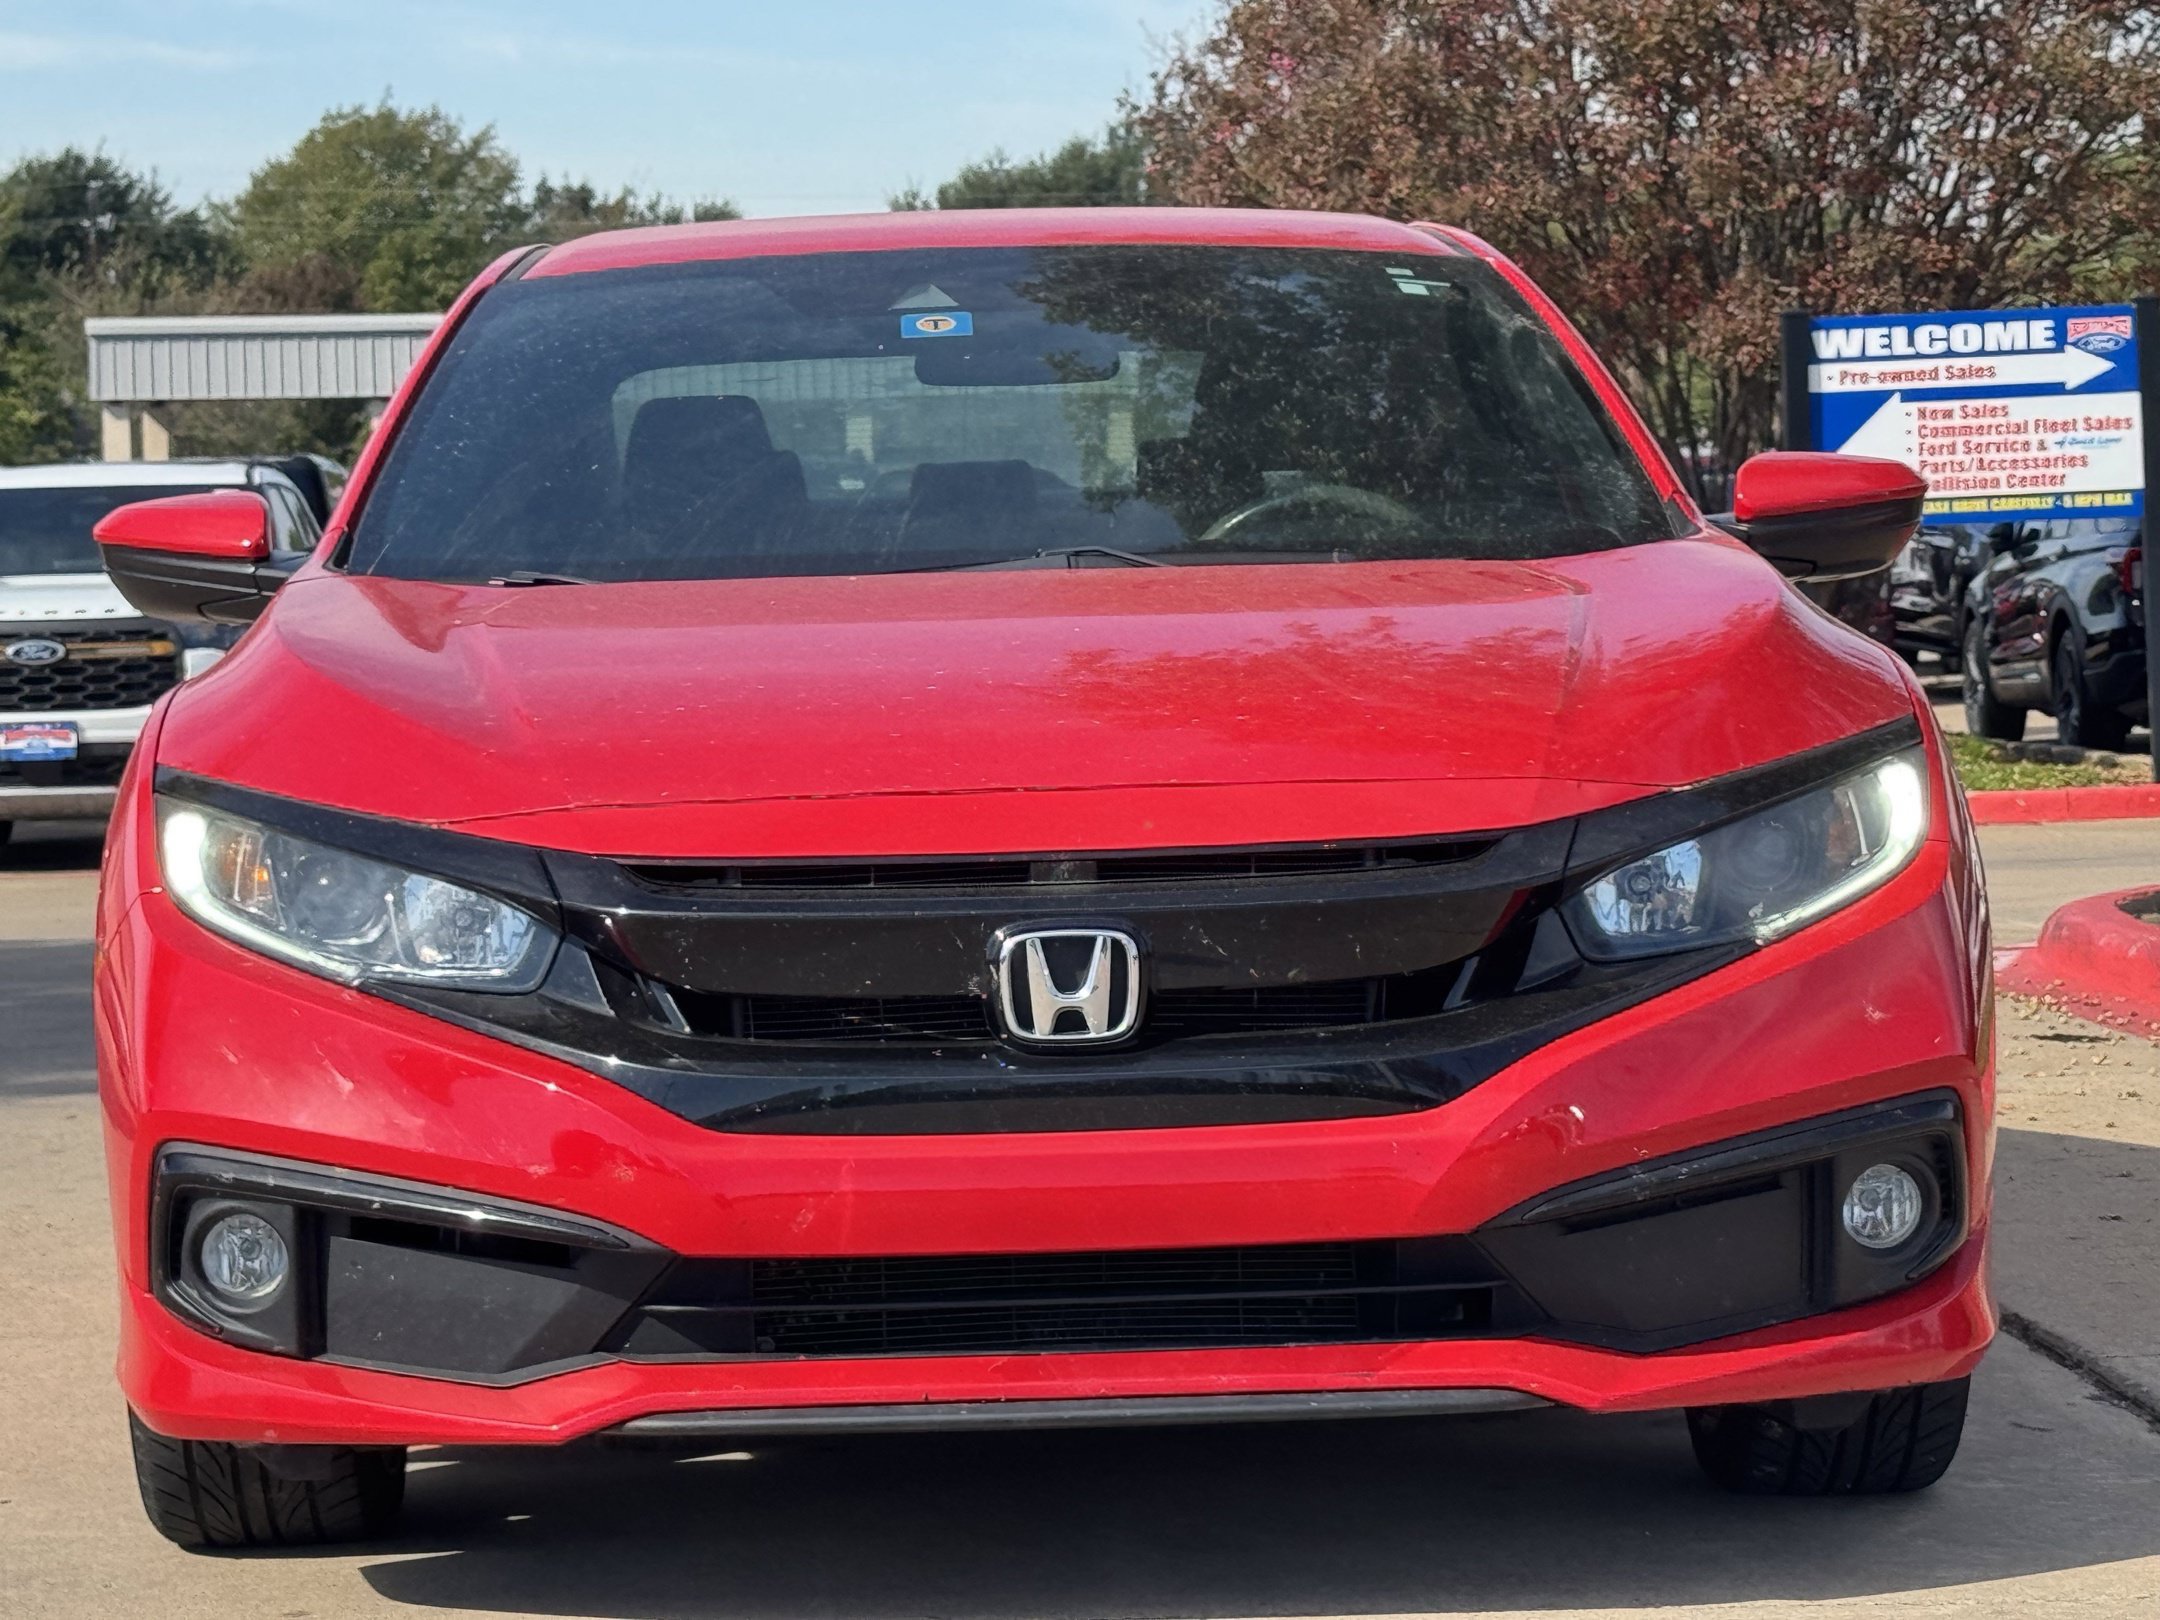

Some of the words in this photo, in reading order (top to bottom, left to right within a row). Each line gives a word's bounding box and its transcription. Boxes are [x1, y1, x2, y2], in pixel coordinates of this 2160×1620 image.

[1811, 320, 2056, 359] WELCOME
[1945, 364, 1996, 379] Sales
[1917, 406, 1954, 420] New
[1959, 404, 2009, 419] Sales
[1918, 419, 2028, 439] Commercial
[2034, 418, 2077, 434] Fleet
[2083, 416, 2132, 432] Sales
[1918, 440, 1956, 456] Ford
[1963, 438, 2031, 455] Service
[1930, 476, 2000, 491] ollision
[2006, 473, 2066, 489] Center
